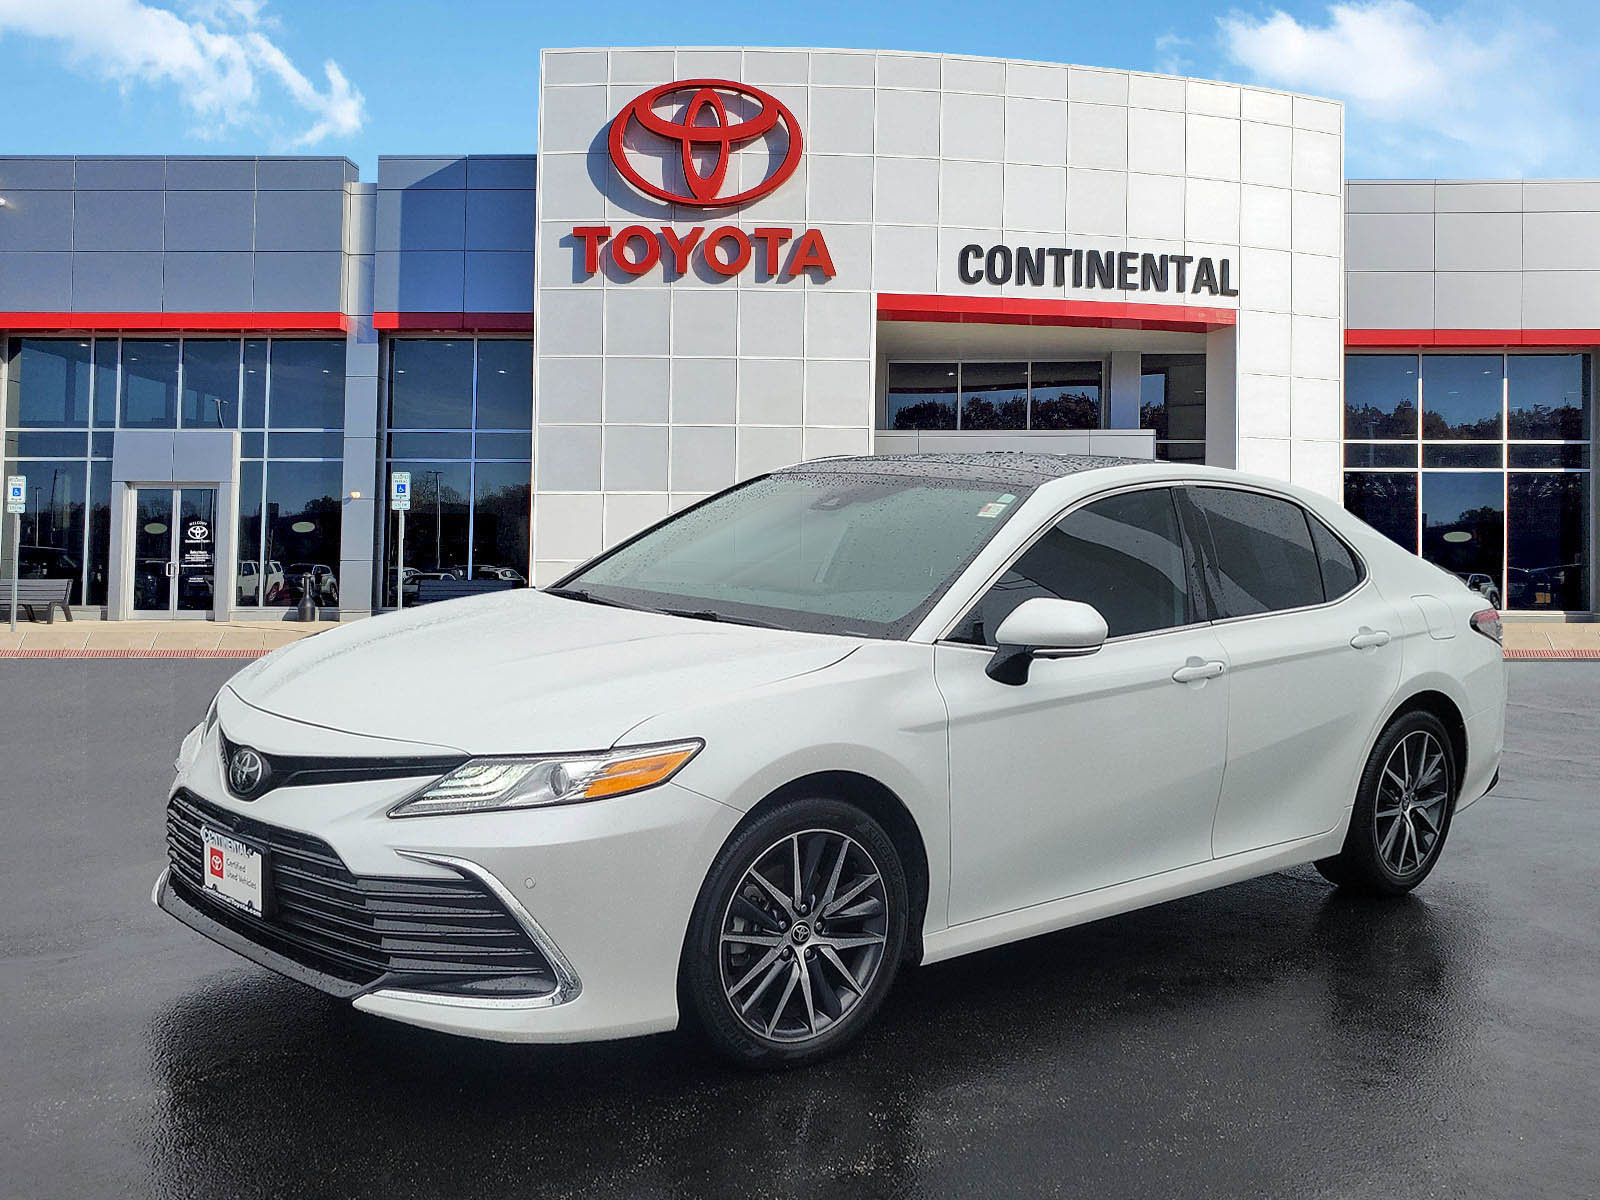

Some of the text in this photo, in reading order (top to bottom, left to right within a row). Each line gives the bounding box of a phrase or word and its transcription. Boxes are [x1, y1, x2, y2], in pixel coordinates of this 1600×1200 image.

[572, 225, 836, 277] TOYOTA
[958, 244, 1239, 297] CONTINENTAL
[226, 858, 246, 873] Certified
[226, 871, 257, 890] Used Vehicles
